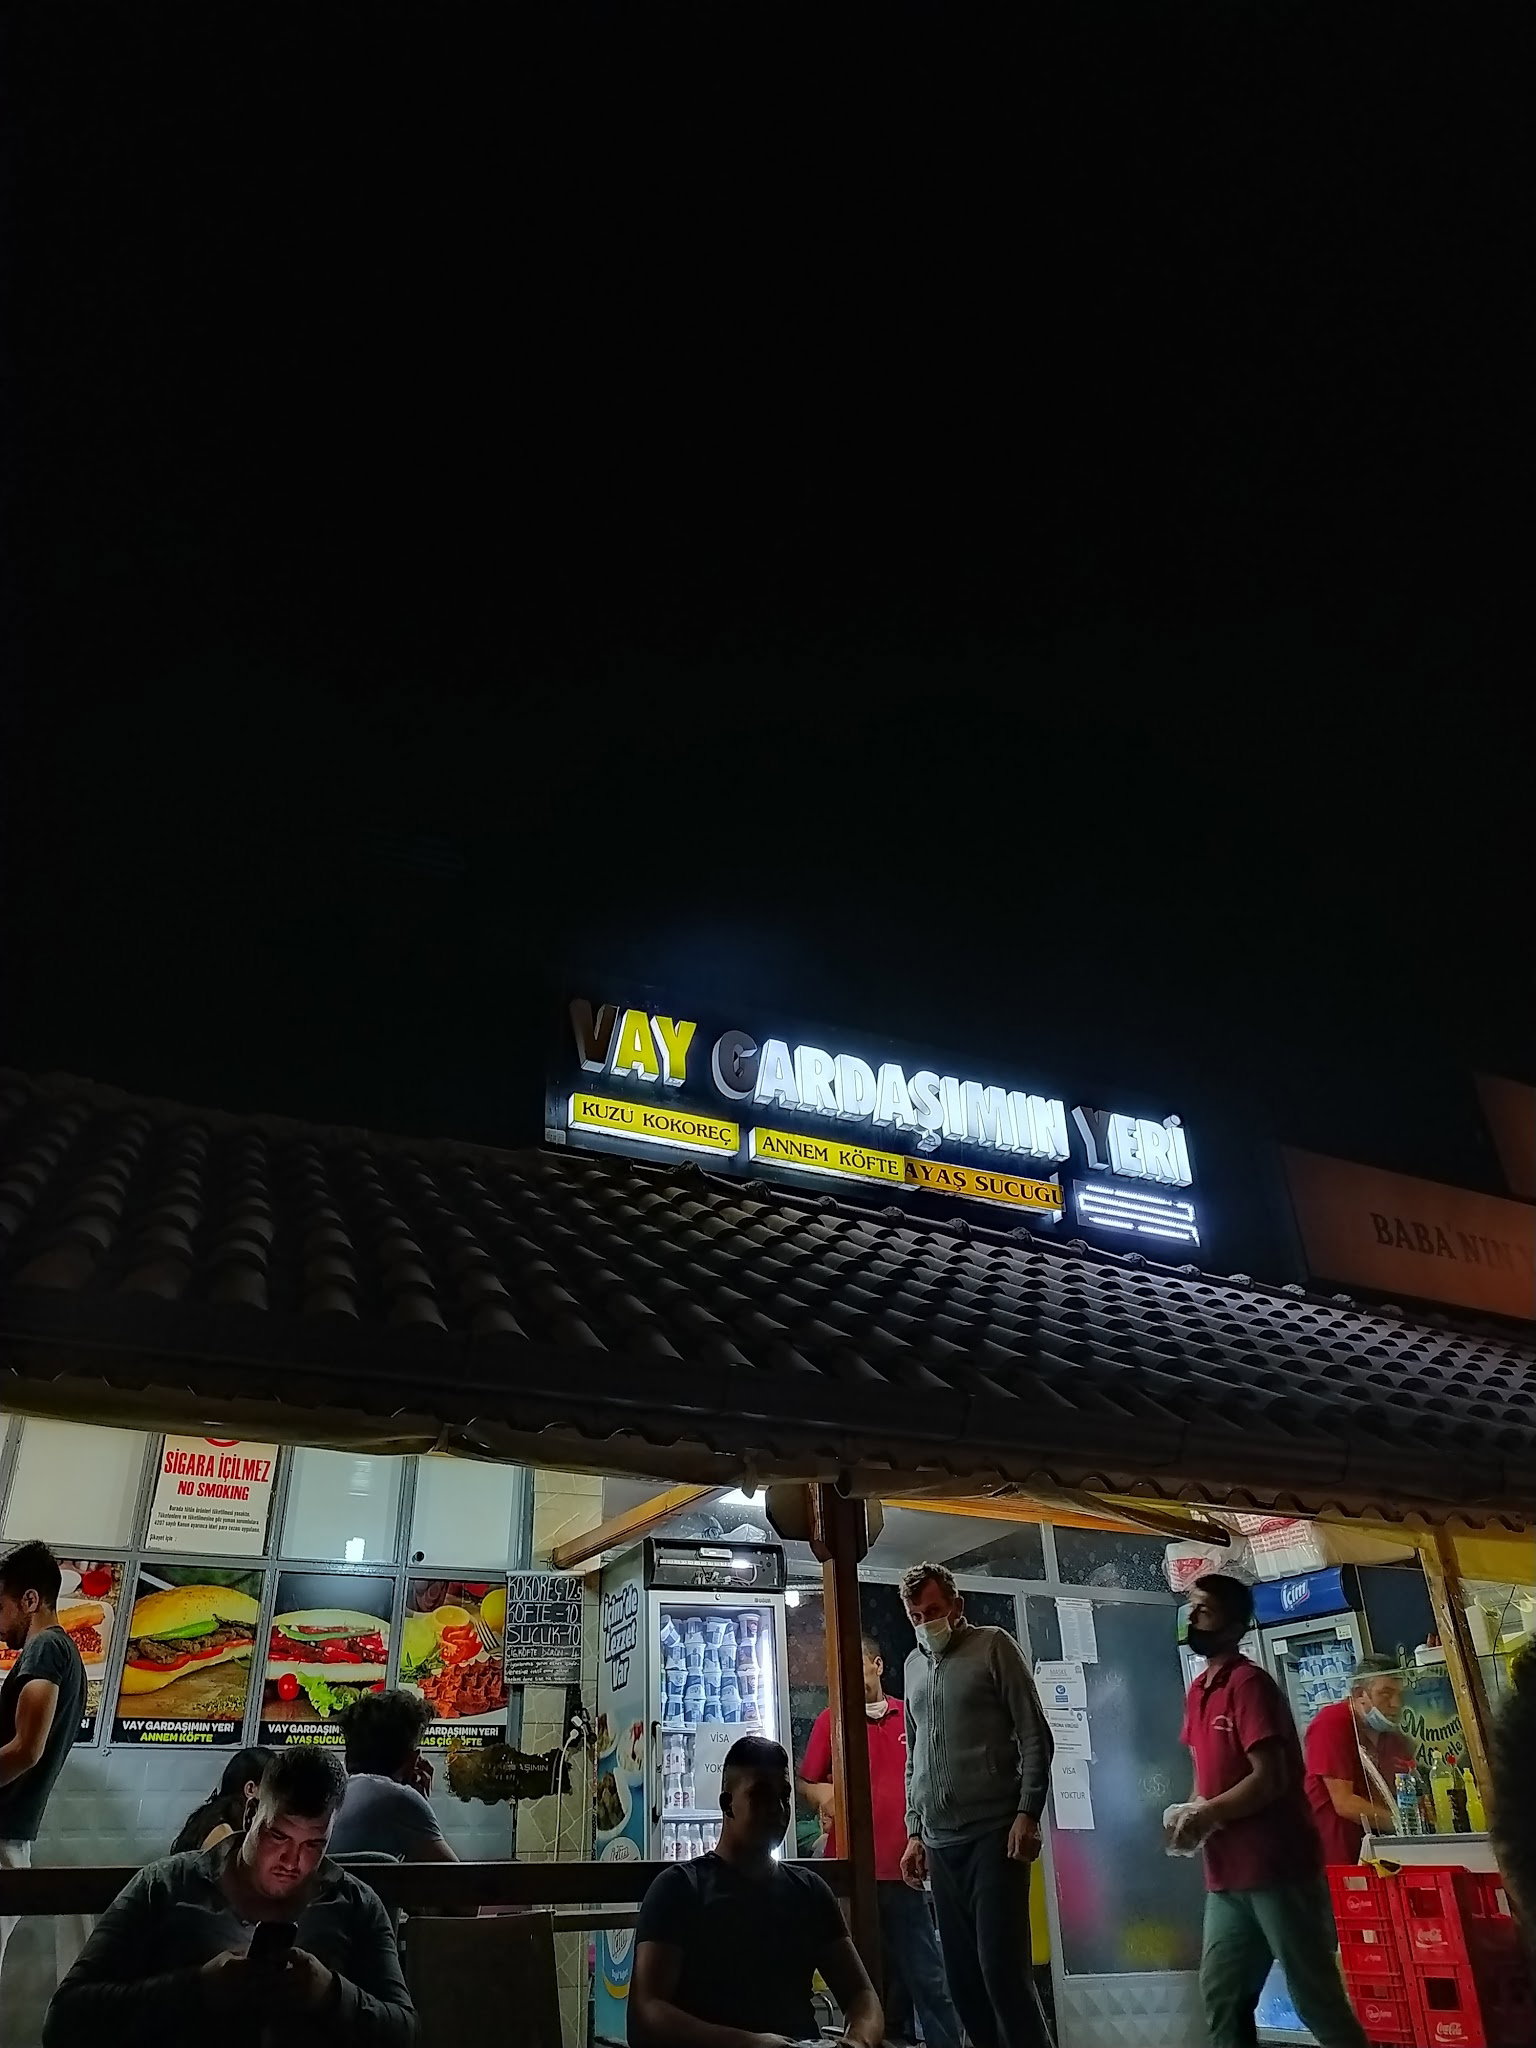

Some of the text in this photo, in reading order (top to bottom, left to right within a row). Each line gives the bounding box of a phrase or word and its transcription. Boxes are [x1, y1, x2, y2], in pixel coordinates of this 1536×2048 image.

[569, 1000, 1193, 1187] VAY GARDAŞIMIN YERİ
[582, 1101, 732, 1146] KUZU KOKOREÇ
[763, 1136, 899, 1176] ANNEM KÖFTE
[905, 1161, 967, 1191] AYAŞ
[164, 1448, 271, 1483] SİGARA İÇİLMEZ
[177, 1481, 250, 1501] NO SMOKING
[1282, 1581, 1308, 1611] İçim
[565, 1603, 579, 1624] 10
[612, 1656, 630, 1692] Var
[122, 1720, 235, 1734] VAY GARDAŞIMIN YERİ
[140, 1730, 213, 1743] ANNEM KÖFTE
[268, 1723, 289, 1734] VAY
[478, 1727, 499, 1737] YERİ
[710, 1732, 730, 1743] VİSA
